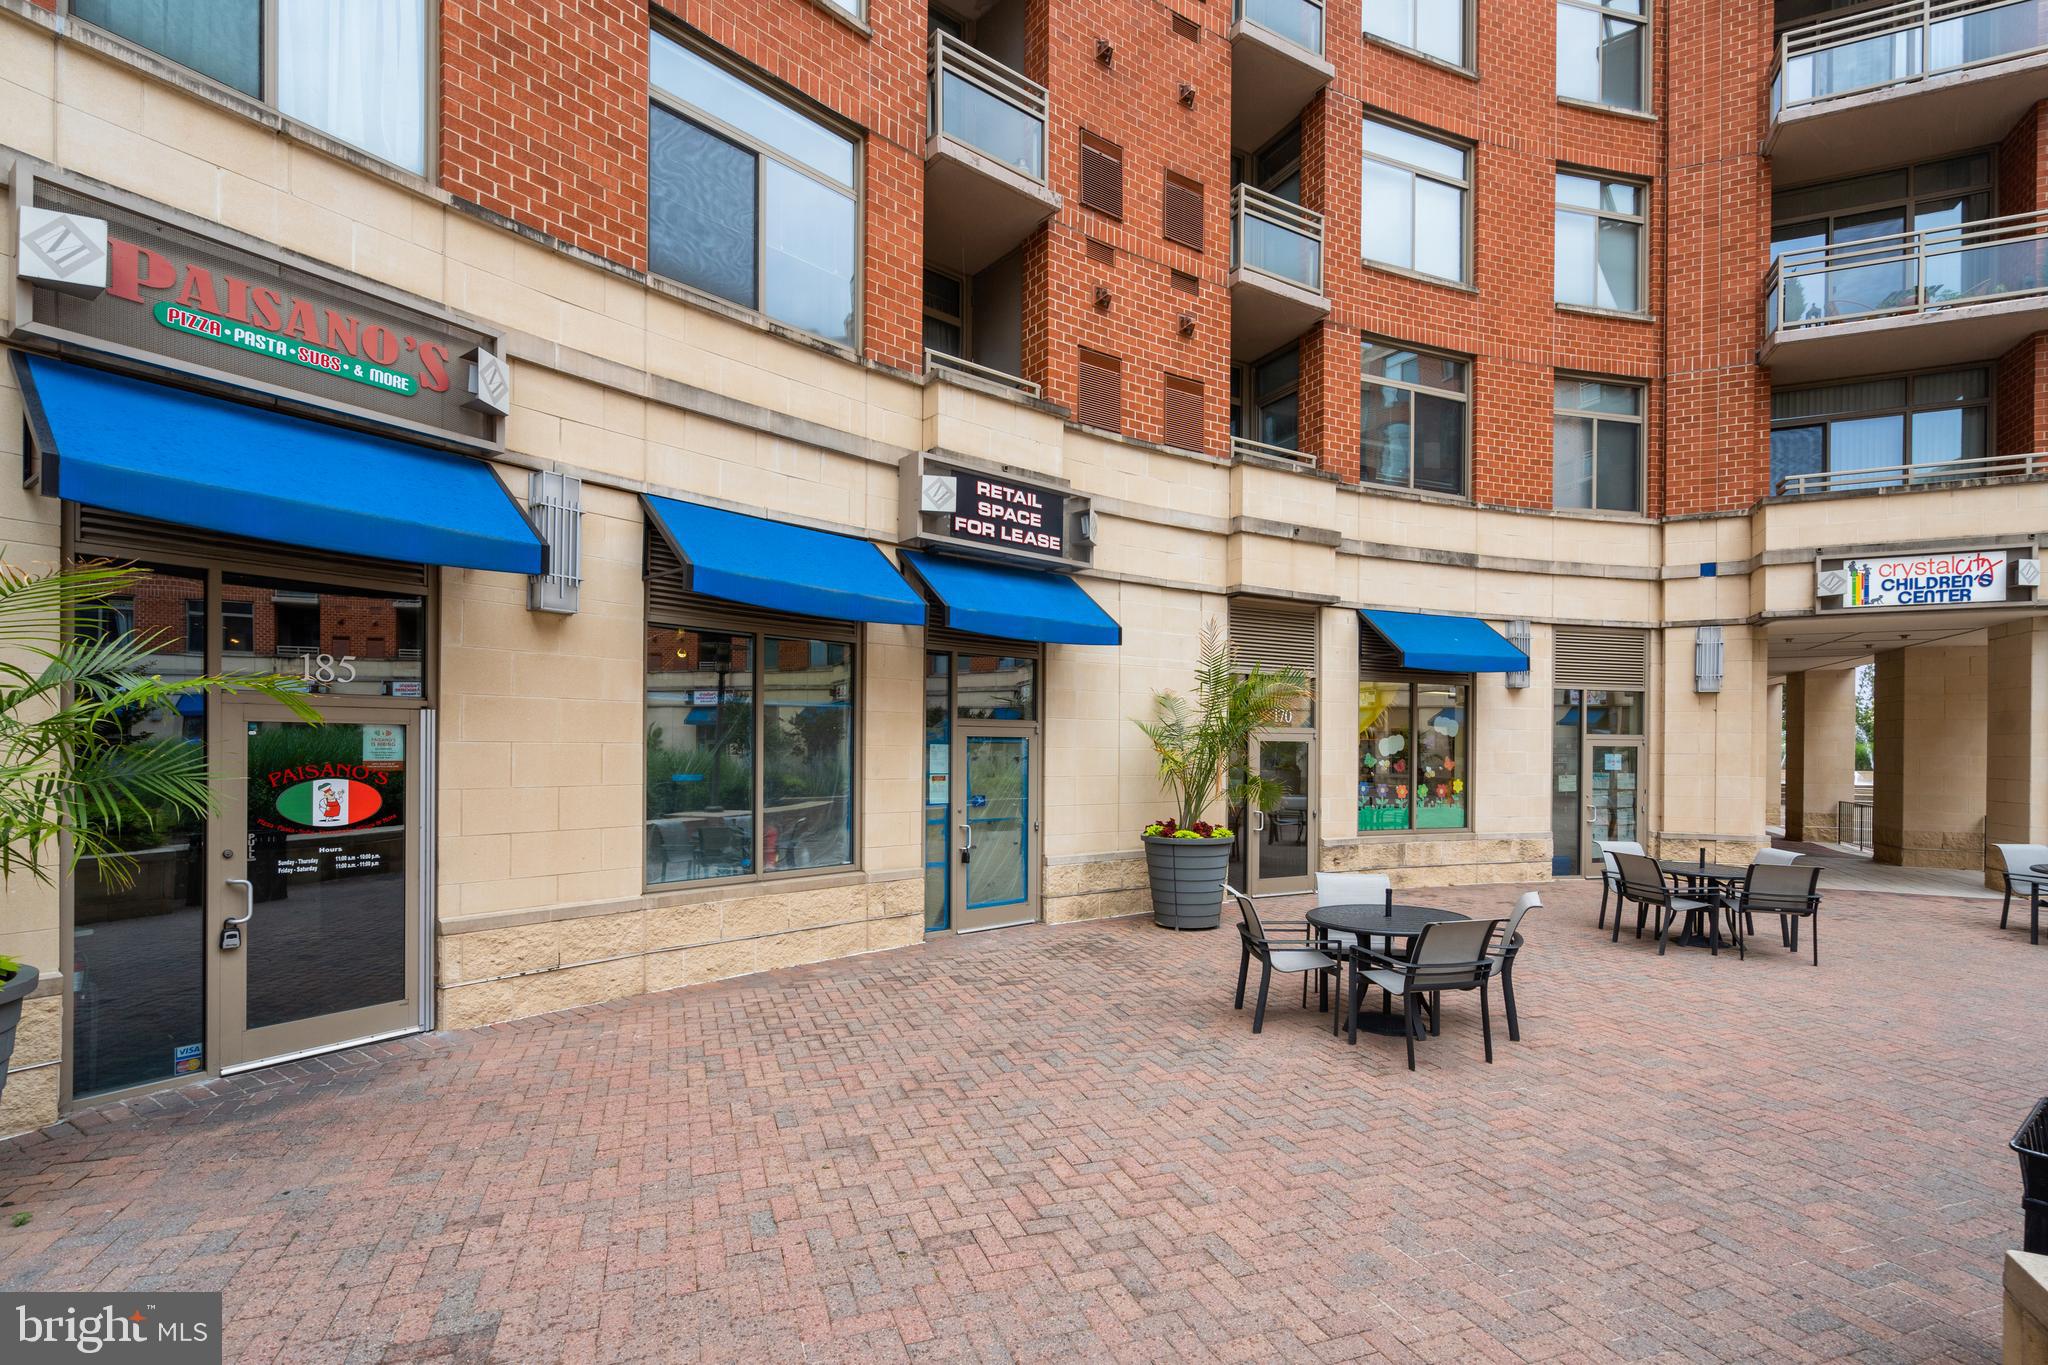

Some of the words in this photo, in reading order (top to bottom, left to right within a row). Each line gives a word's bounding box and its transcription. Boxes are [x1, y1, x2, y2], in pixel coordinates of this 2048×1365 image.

[107, 236, 449, 392] PAISANO'S
[166, 307, 222, 337] PIZZA
[233, 327, 287, 356] PASTA
[297, 346, 342, 372] SUBS
[353, 364, 364, 378] &
[369, 368, 410, 392] MORE
[976, 480, 1042, 508] RETAIL
[977, 501, 1042, 528] SPACE
[954, 516, 996, 538] FOR
[1000, 526, 1061, 551] LEASE
[300, 653, 357, 684] 185
[268, 762, 388, 789] PAISANO'S
[278, 859, 295, 867] Sunday
[296, 865, 318, 873] Saturday
[179, 1046, 200, 1055] VISA
